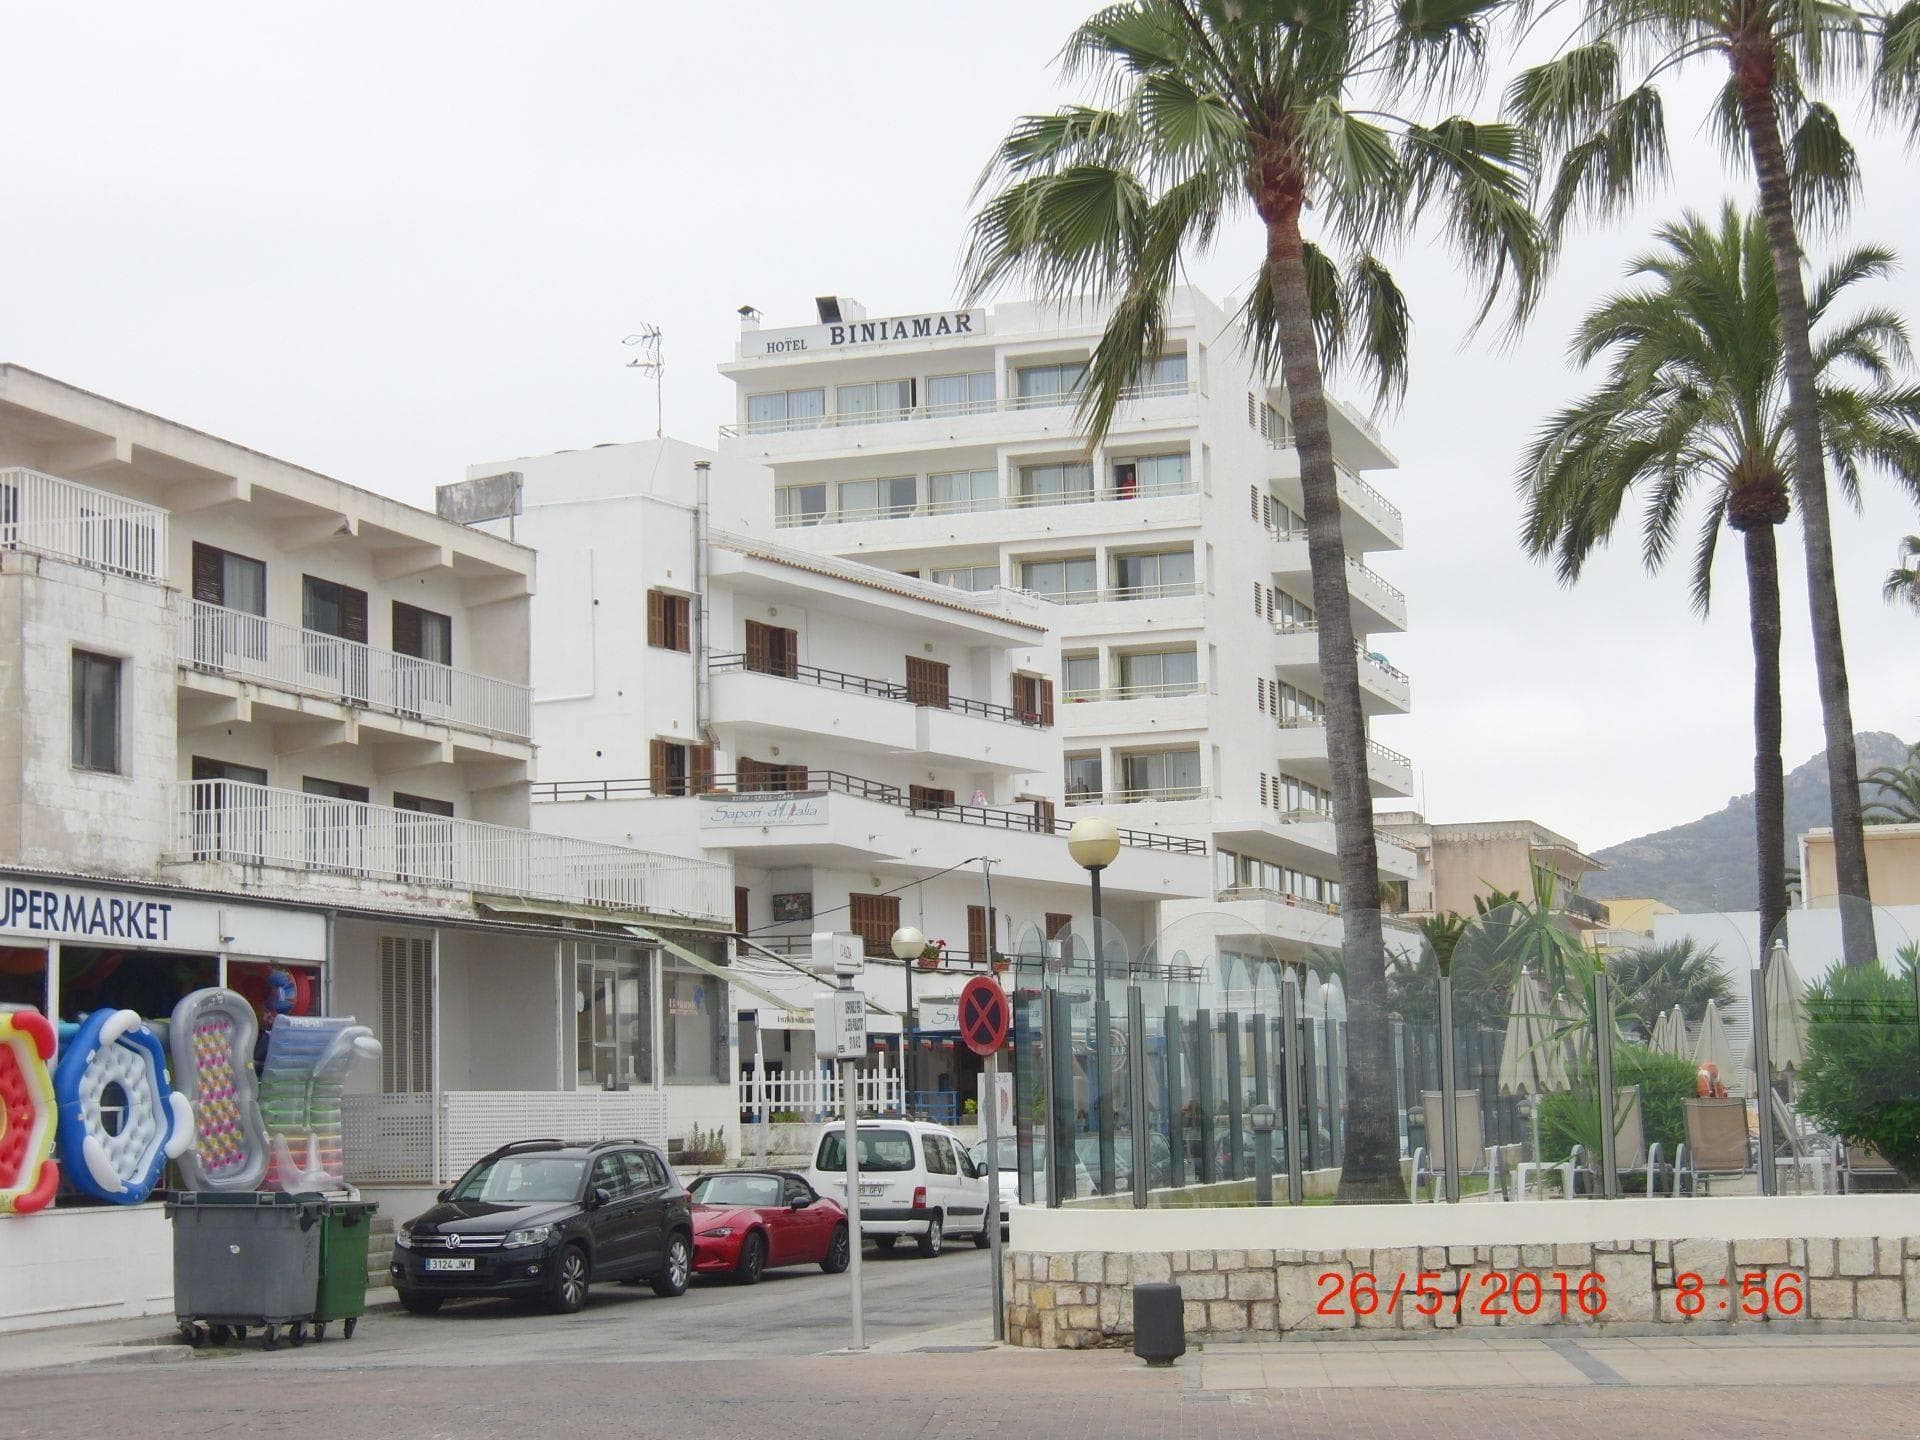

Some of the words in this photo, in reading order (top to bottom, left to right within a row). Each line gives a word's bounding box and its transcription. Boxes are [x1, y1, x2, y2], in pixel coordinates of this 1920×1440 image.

[766, 338, 808, 354] HOTEL
[830, 313, 972, 346] BINIAMAR
[710, 803, 762, 824] Sapori
[0, 887, 172, 941] UPERMARKET
[432, 1260, 453, 1269] 3124
